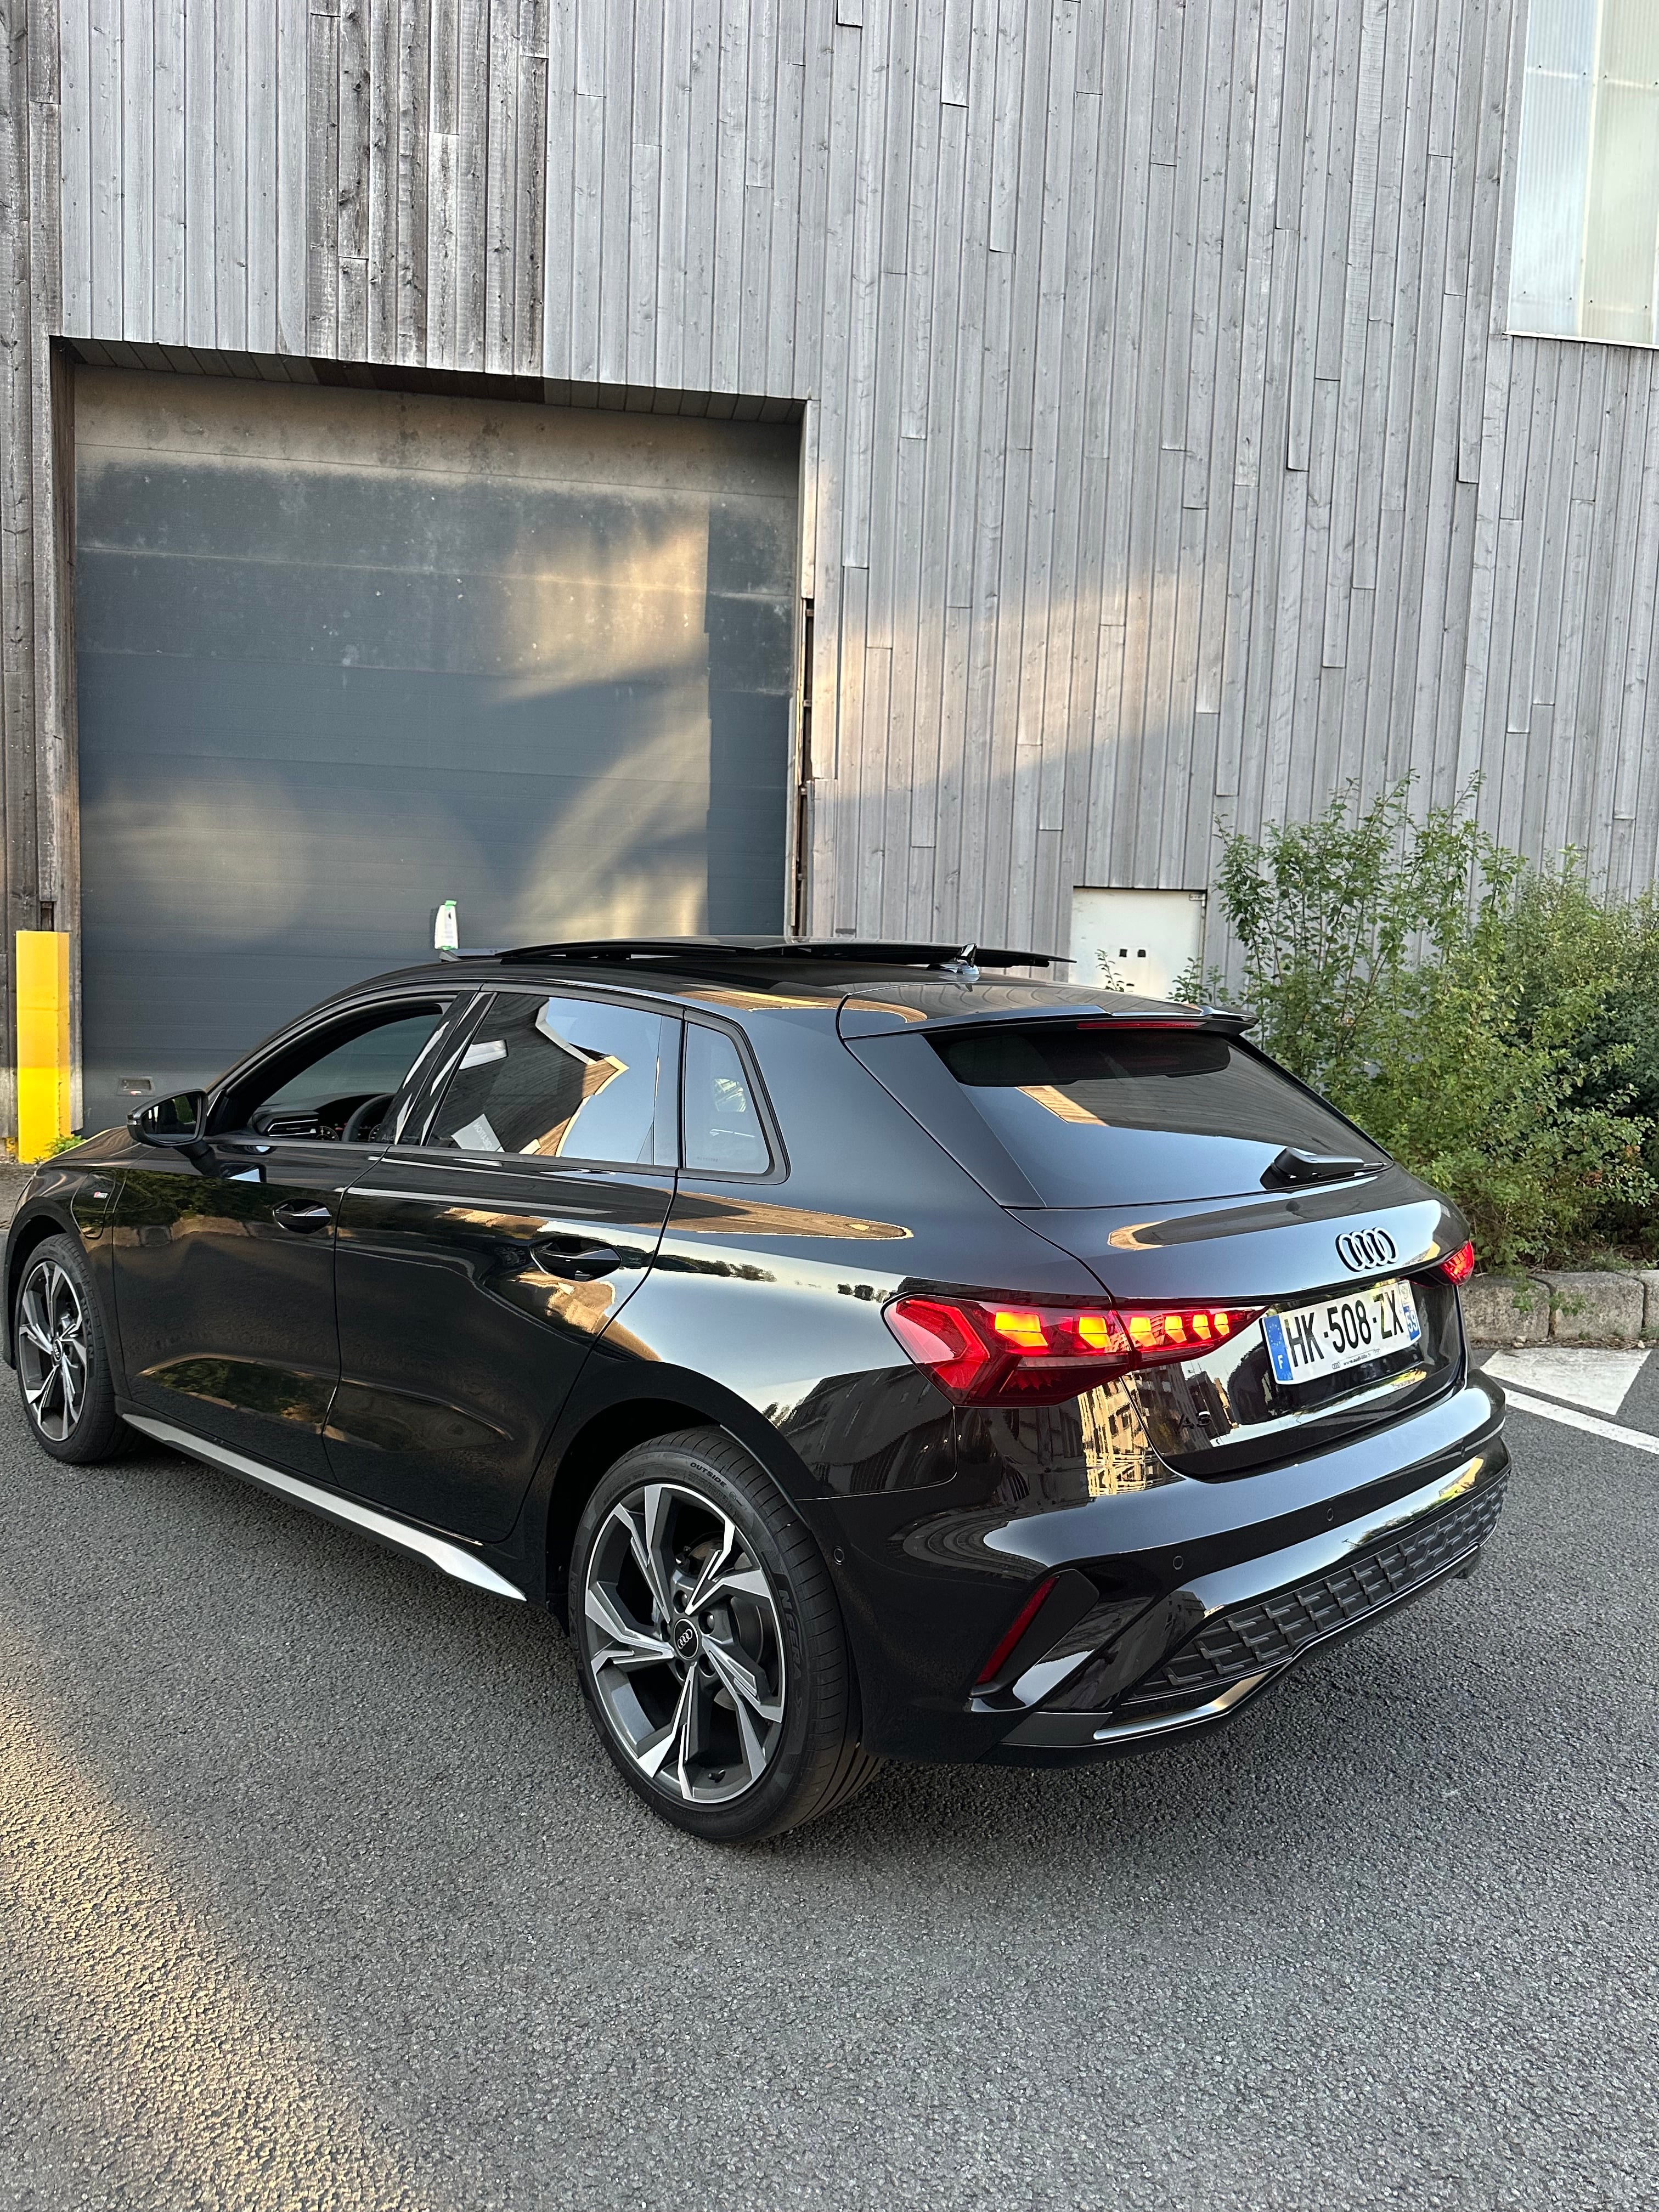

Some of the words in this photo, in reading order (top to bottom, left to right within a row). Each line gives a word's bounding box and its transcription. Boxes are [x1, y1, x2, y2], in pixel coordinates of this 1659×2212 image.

[1284, 1290, 1404, 1367] HK-508-ZX
[1405, 1310, 1419, 1333] 59
[1277, 1355, 1283, 1369] F
[690, 1462, 727, 1488] OUTSIDE
